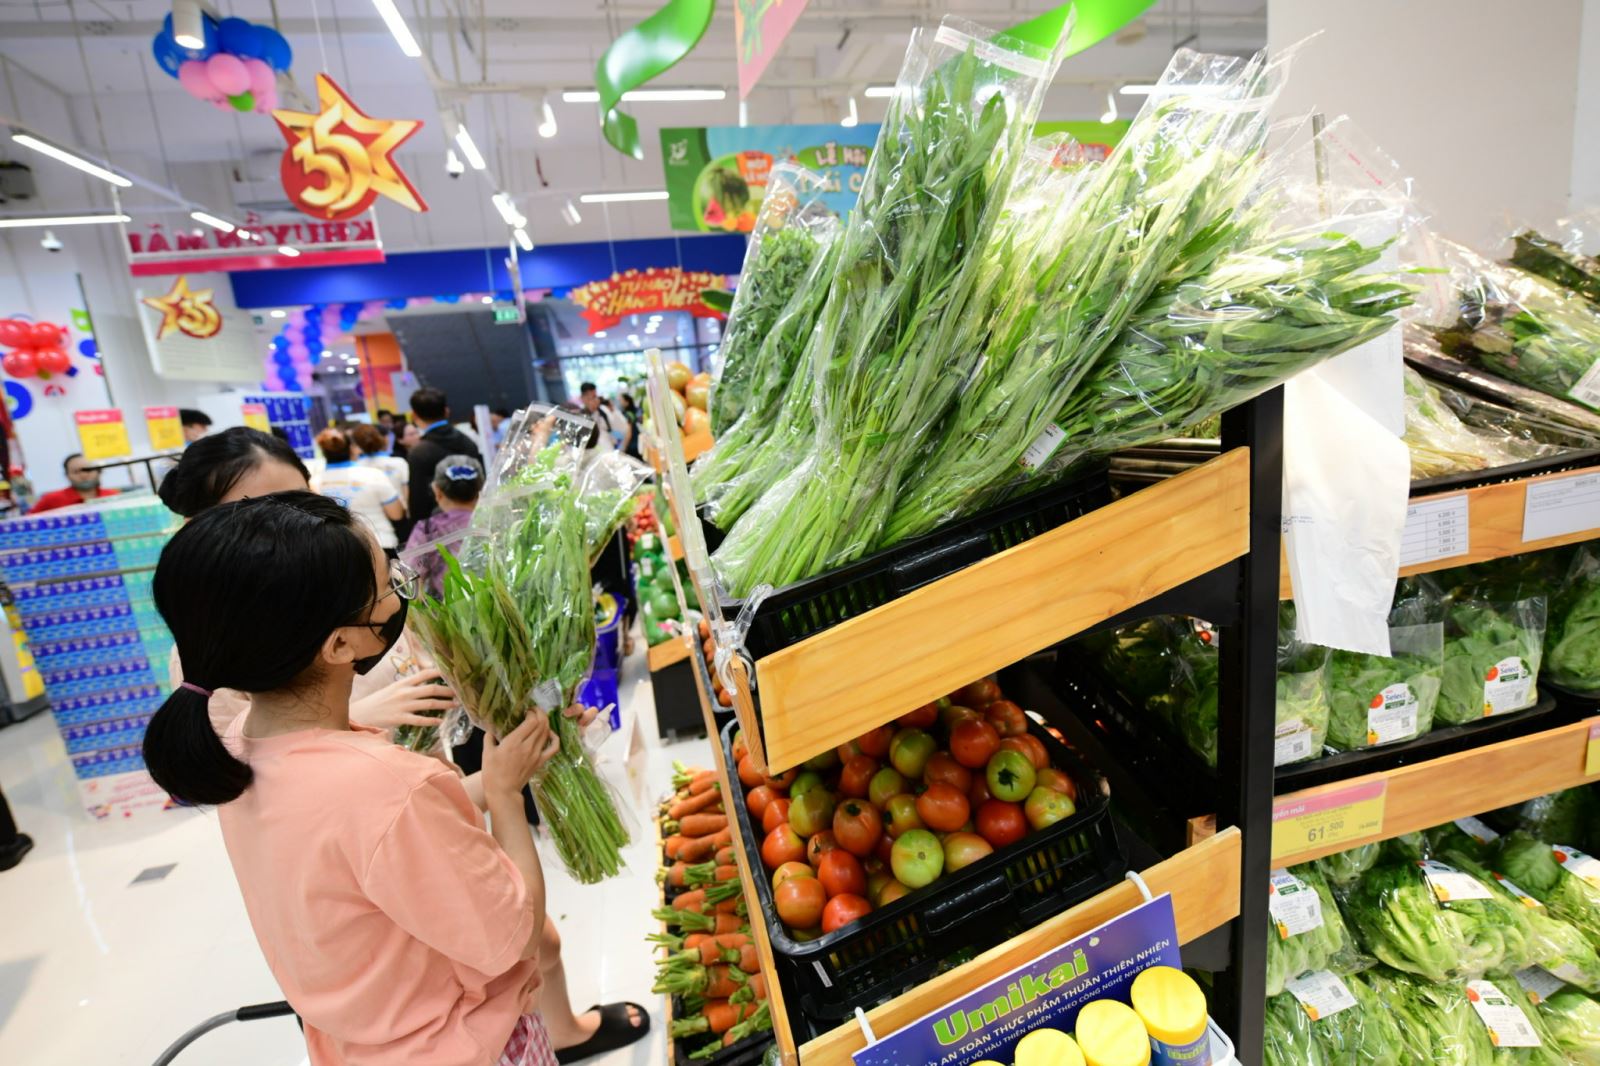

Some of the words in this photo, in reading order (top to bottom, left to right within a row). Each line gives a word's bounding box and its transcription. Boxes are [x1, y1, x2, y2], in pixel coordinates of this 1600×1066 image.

[1308, 826, 1325, 842] 61
[933, 948, 1089, 1046] Umikai
[941, 1051, 957, 1066] AN
[959, 1033, 991, 1056] TOÀN
[993, 1015, 1025, 1037] THỰC
[1027, 996, 1061, 1020] PHẨM
[1062, 976, 1101, 1000] THUẦN
[1102, 958, 1135, 979] THIÊN
[1136, 939, 1170, 962] NHIÊN
[1003, 1028, 1026, 1043] THIÊN
[1027, 1013, 1052, 1030] NHIÊN
[1057, 1000, 1078, 1014] THEO
[1079, 987, 1101, 1003] CÔNG
[1102, 975, 1123, 992] NGHỆ
